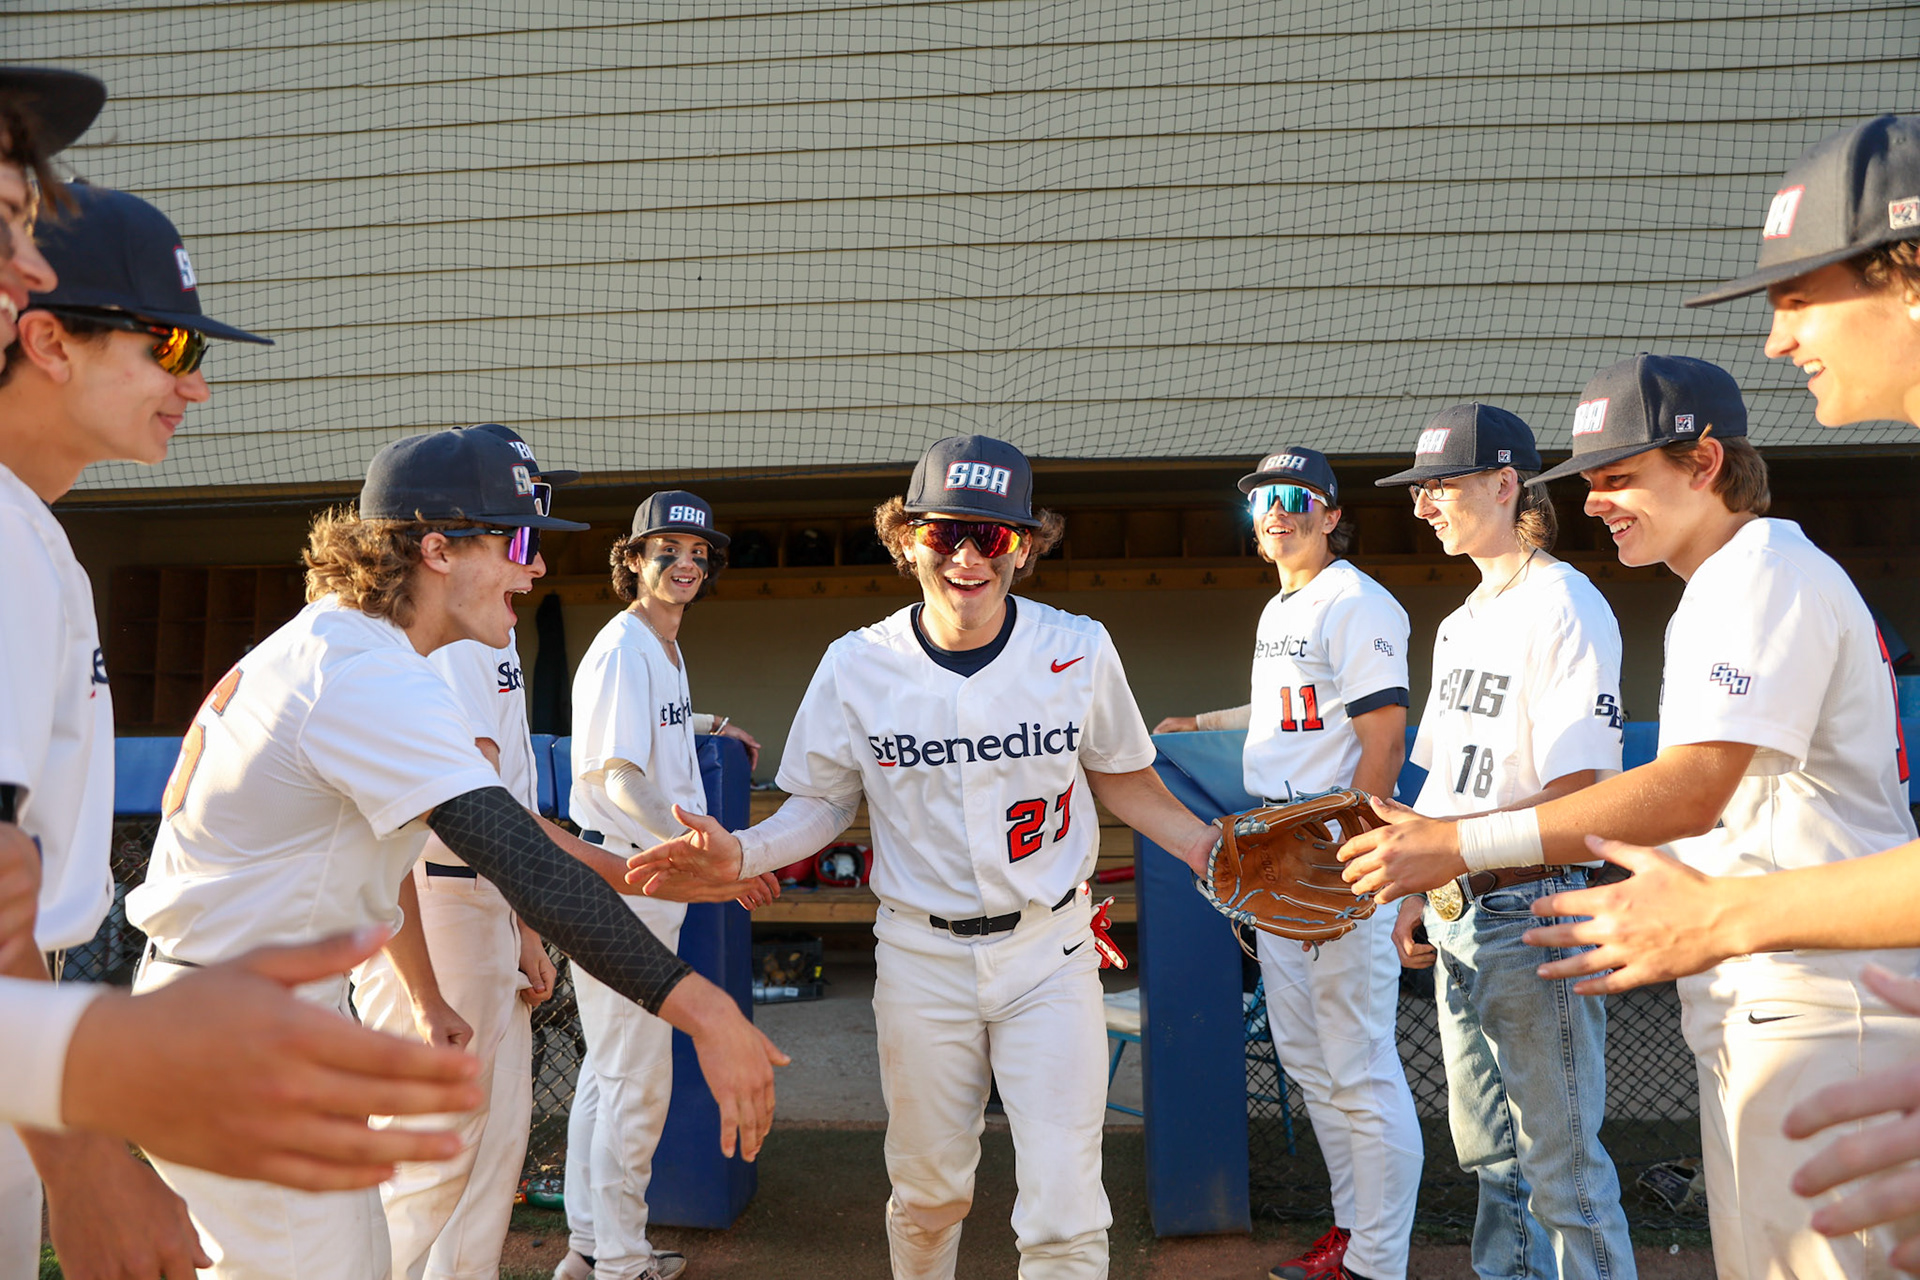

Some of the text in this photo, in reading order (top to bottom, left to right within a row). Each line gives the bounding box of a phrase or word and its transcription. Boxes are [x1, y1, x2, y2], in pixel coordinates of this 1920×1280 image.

[1571, 397, 1610, 437] BA
[1415, 428, 1452, 456] BA
[944, 460, 1013, 498] SBA
[1261, 453, 1309, 472] SBA
[668, 504, 707, 528] SBA
[1373, 637, 1395, 657] SBA
[1709, 662, 1751, 695] SBA
[1280, 684, 1324, 732] 11
[1594, 693, 1624, 745] SB
[1453, 744, 1494, 799] 18
